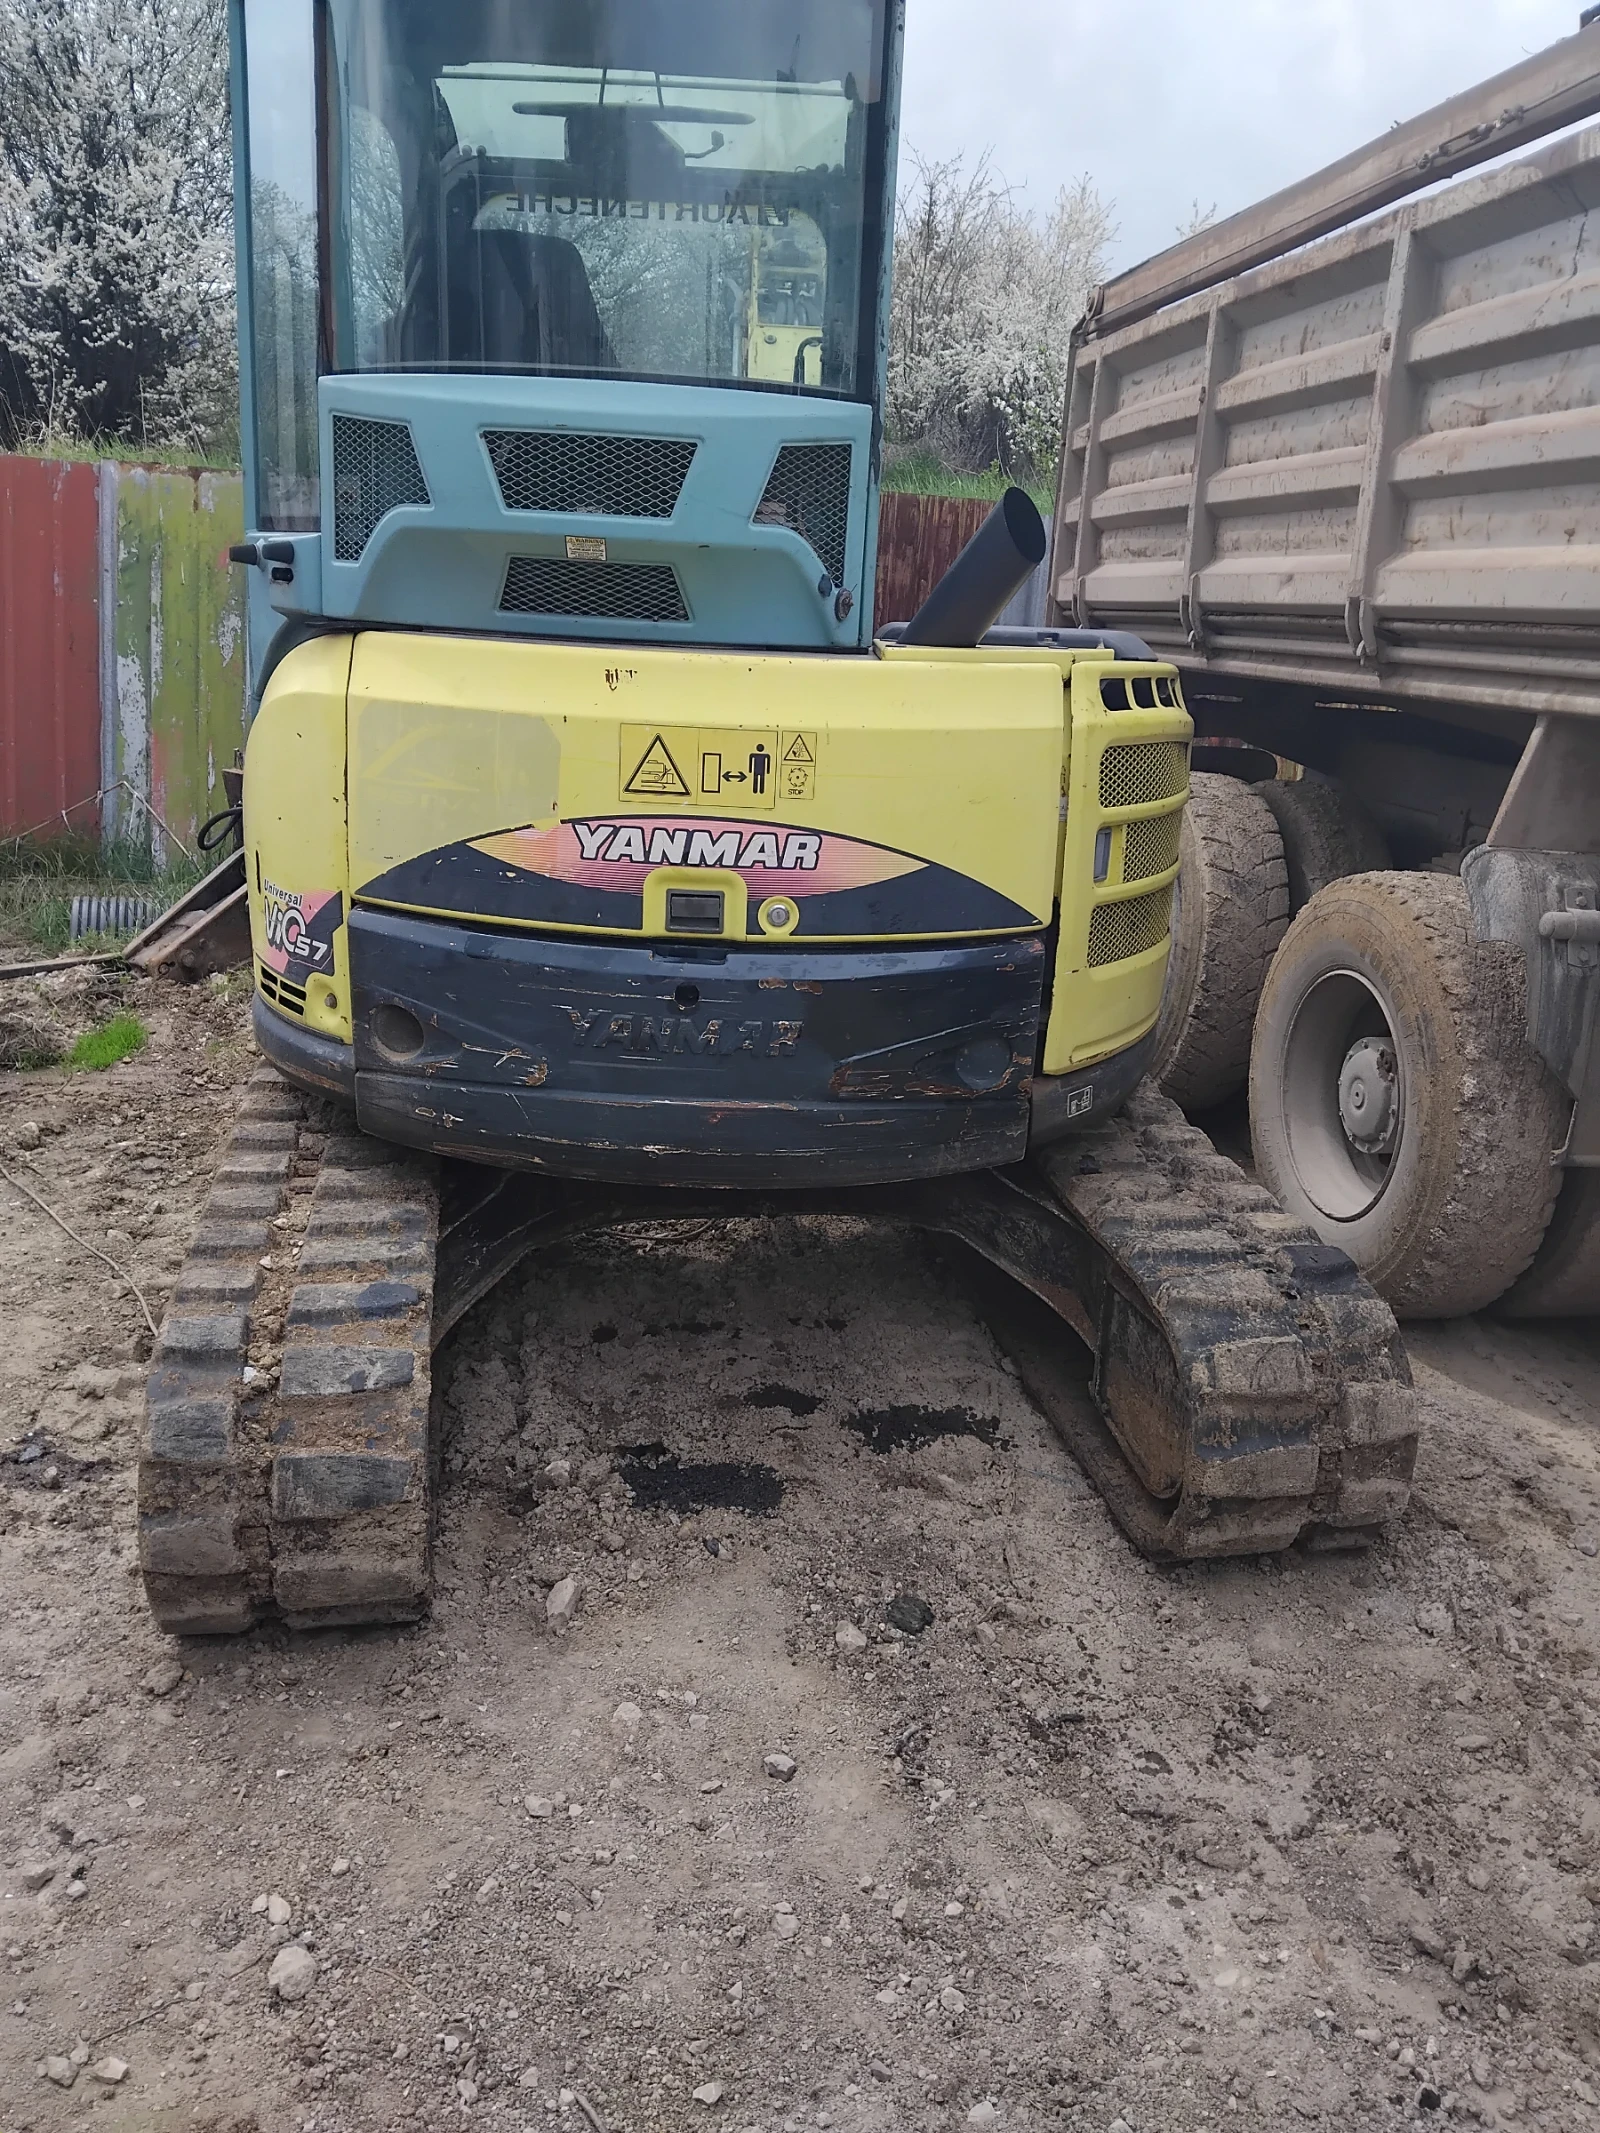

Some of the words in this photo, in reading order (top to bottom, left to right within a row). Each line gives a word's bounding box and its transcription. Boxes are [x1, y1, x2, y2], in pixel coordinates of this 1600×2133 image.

[787, 788, 804, 796] STOP
[572, 823, 822, 870] YANMAR
[264, 879, 302, 907] Universal
[566, 1009, 804, 1057] YANMAR
